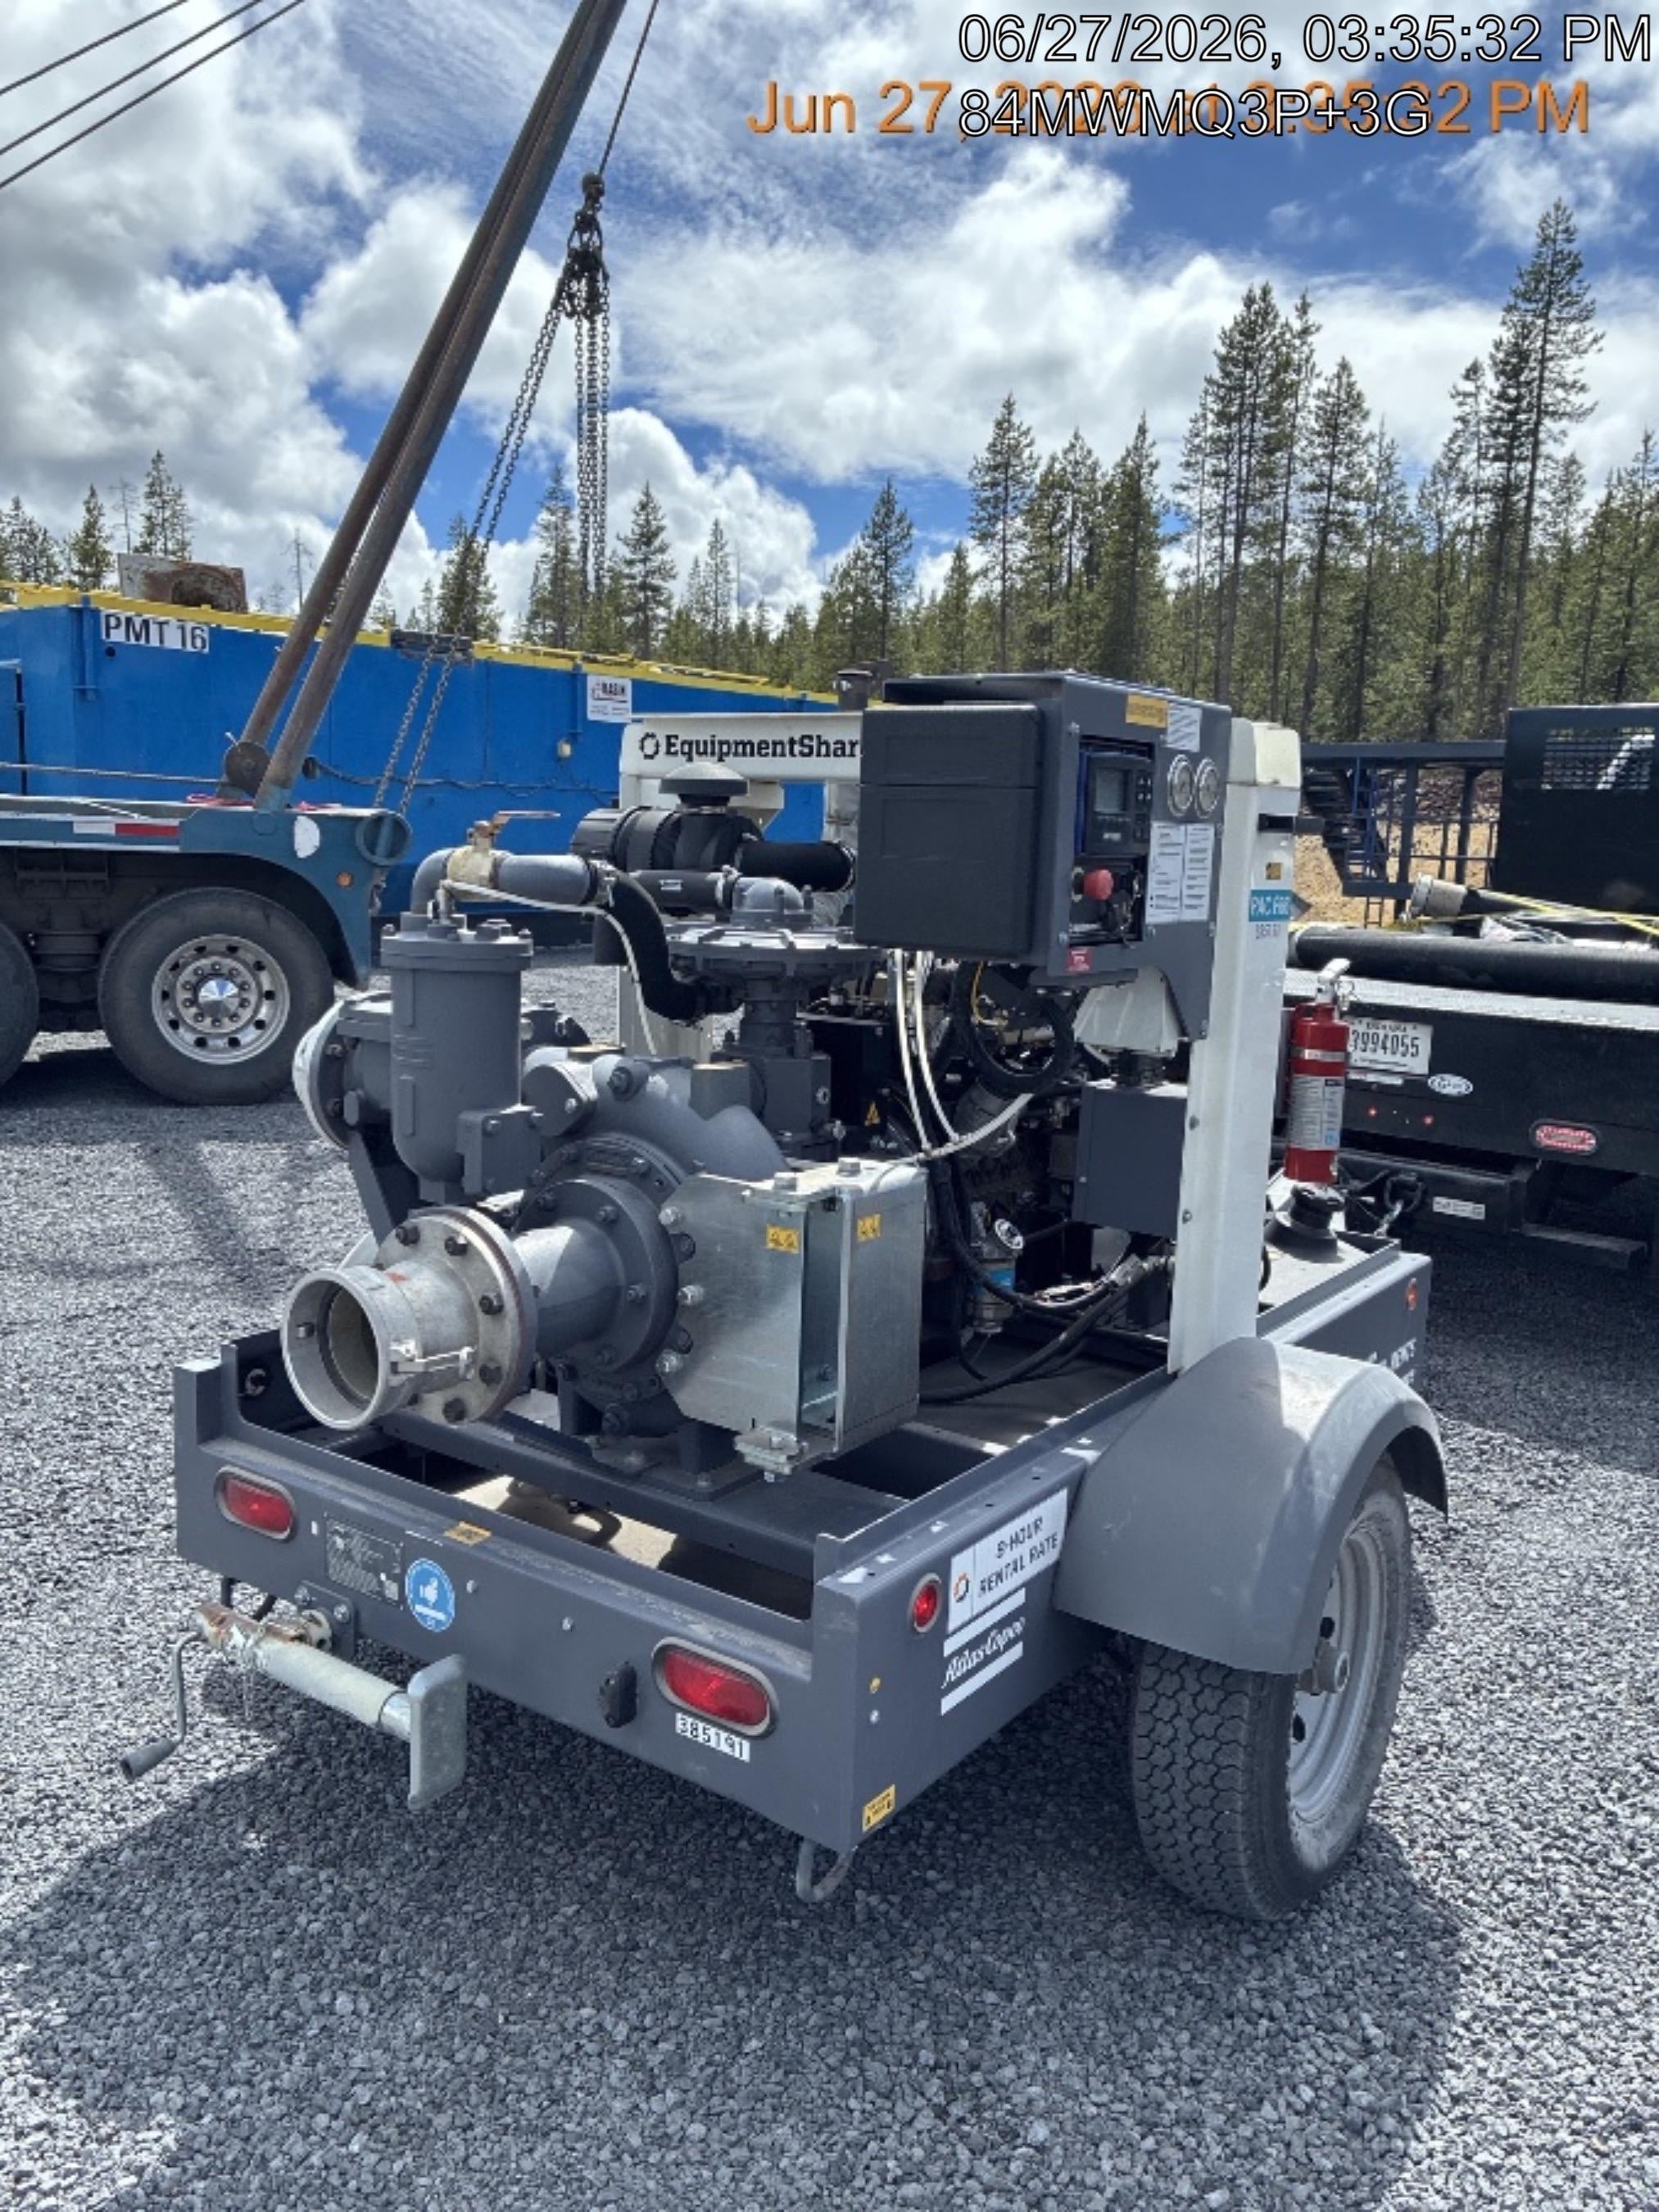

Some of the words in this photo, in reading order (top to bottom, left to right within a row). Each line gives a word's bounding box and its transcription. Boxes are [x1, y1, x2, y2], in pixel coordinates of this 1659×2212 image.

[104, 614, 170, 646] PMT
[177, 623, 207, 650] 16
[664, 734, 863, 762] EquipmentShar
[978, 1554, 1026, 1598] RENTAL
[1030, 1532, 1058, 1564] RATE
